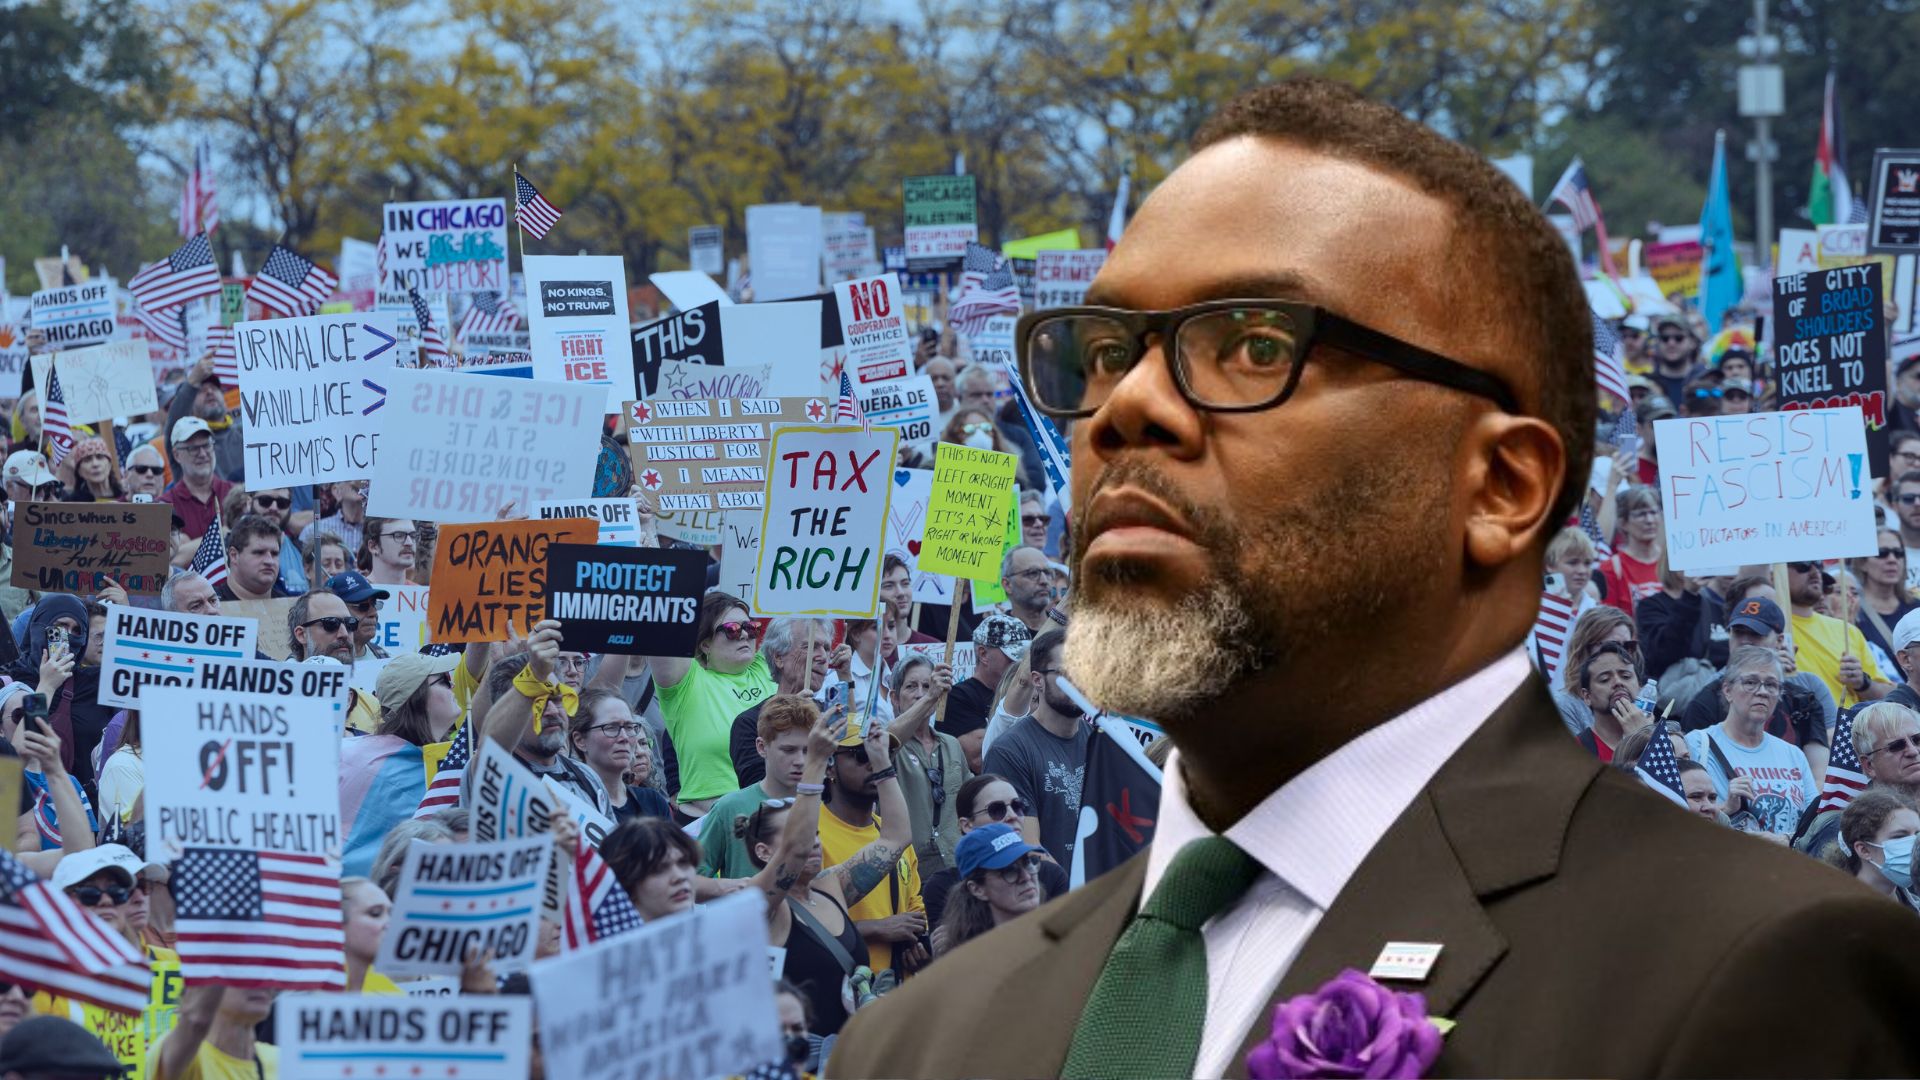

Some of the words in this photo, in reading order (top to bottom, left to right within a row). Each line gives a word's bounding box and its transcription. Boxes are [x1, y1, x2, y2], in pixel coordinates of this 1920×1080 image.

[906, 187, 972, 203] CHICAGO
[389, 209, 412, 231] IN
[416, 205, 504, 231] CHICAGO
[906, 209, 973, 225] PALESTINE
[396, 241, 425, 259] WE
[393, 269, 430, 291] NOT
[433, 260, 503, 291] DEPORT
[1777, 272, 1808, 295] THE
[1825, 266, 1872, 290] CITY
[33, 291, 78, 307] HANDS
[81, 285, 108, 301] OFF
[548, 288, 566, 297] NO
[849, 279, 890, 322] NO
[1788, 297, 1807, 317] OF
[1821, 287, 1873, 314] BROAD
[548, 302, 566, 311] NO
[566, 301, 610, 311] TRUMP
[46, 319, 113, 343] HICAGO
[635, 309, 706, 363] THIS
[847, 317, 901, 336] COOPERATION
[1795, 309, 1874, 339] SHOULDERS
[239, 325, 320, 372] URINAL
[322, 322, 357, 363] ICE
[516, 334, 531, 348] OF
[561, 338, 604, 357] FIGHT
[850, 333, 881, 346] WITH
[1780, 338, 1820, 367] DOES
[1831, 331, 1866, 360] NOT
[565, 362, 608, 381] ICE
[1782, 364, 1832, 397] KNEEL
[1840, 360, 1864, 388] TO
[119, 388, 152, 410] FEW
[240, 388, 321, 429] VANILLA
[324, 382, 353, 418] ICE
[658, 404, 708, 417] WHEN
[722, 403, 728, 416] I
[742, 401, 780, 414] SAID
[861, 396, 903, 413] UERA
[907, 389, 928, 403] DE
[692, 425, 759, 441] LIBERTY
[1689, 412, 1840, 467] RESIST
[648, 446, 714, 460] JUSTICE
[728, 443, 759, 457] FOR
[940, 447, 963, 461] THIS
[967, 450, 977, 462] IS
[980, 452, 1000, 465] NOT
[1002, 455, 1011, 468] A
[681, 470, 687, 482] I
[704, 467, 762, 482] MEANT
[783, 449, 881, 494] TAX
[937, 469, 968, 484] LEFT
[969, 474, 980, 485] OR
[979, 474, 1013, 491] RIGHT
[946, 489, 995, 510] MOMENT
[1671, 453, 1864, 520] FASCISM!
[602, 504, 631, 522] OFF
[662, 495, 710, 509] WHAT
[720, 493, 764, 508] ABOU
[25, 505, 76, 526] Since
[122, 512, 137, 525] is
[791, 507, 847, 538] THE
[934, 509, 964, 525] IT'S
[970, 514, 977, 527] A
[33, 527, 91, 553] Liberty
[101, 531, 167, 553] Justice
[926, 526, 956, 541] RIGHT
[959, 532, 970, 542] OR
[971, 532, 1002, 547] WRONG
[1672, 532, 1696, 554] NO
[1699, 524, 1759, 547] DICTATORS
[1765, 521, 1782, 537] IN
[64, 551, 95, 567] for
[769, 546, 871, 592] RICH
[936, 546, 988, 568] MOMENT
[478, 568, 545, 600] LIES
[576, 561, 676, 592] PROTECT
[437, 598, 545, 638] MATTE
[553, 591, 697, 624] IMMIGRANTS
[118, 613, 198, 645] HANDS
[205, 624, 246, 647] OFF
[607, 635, 634, 645] ACLU
[201, 663, 293, 696] HANDS
[302, 670, 344, 698] OFF
[197, 701, 290, 736] HANDS
[200, 738, 295, 797] OFF!
[1750, 766, 1802, 781] KINGS
[481, 756, 504, 806] OFF
[160, 806, 241, 846] PUBLIC
[252, 812, 337, 853] HEALTH
[416, 852, 505, 883] HANDS
[509, 845, 544, 878] OFF
[395, 921, 529, 964] CHICAGO
[299, 1008, 427, 1042] HANDS
[439, 1009, 510, 1043] OFF
